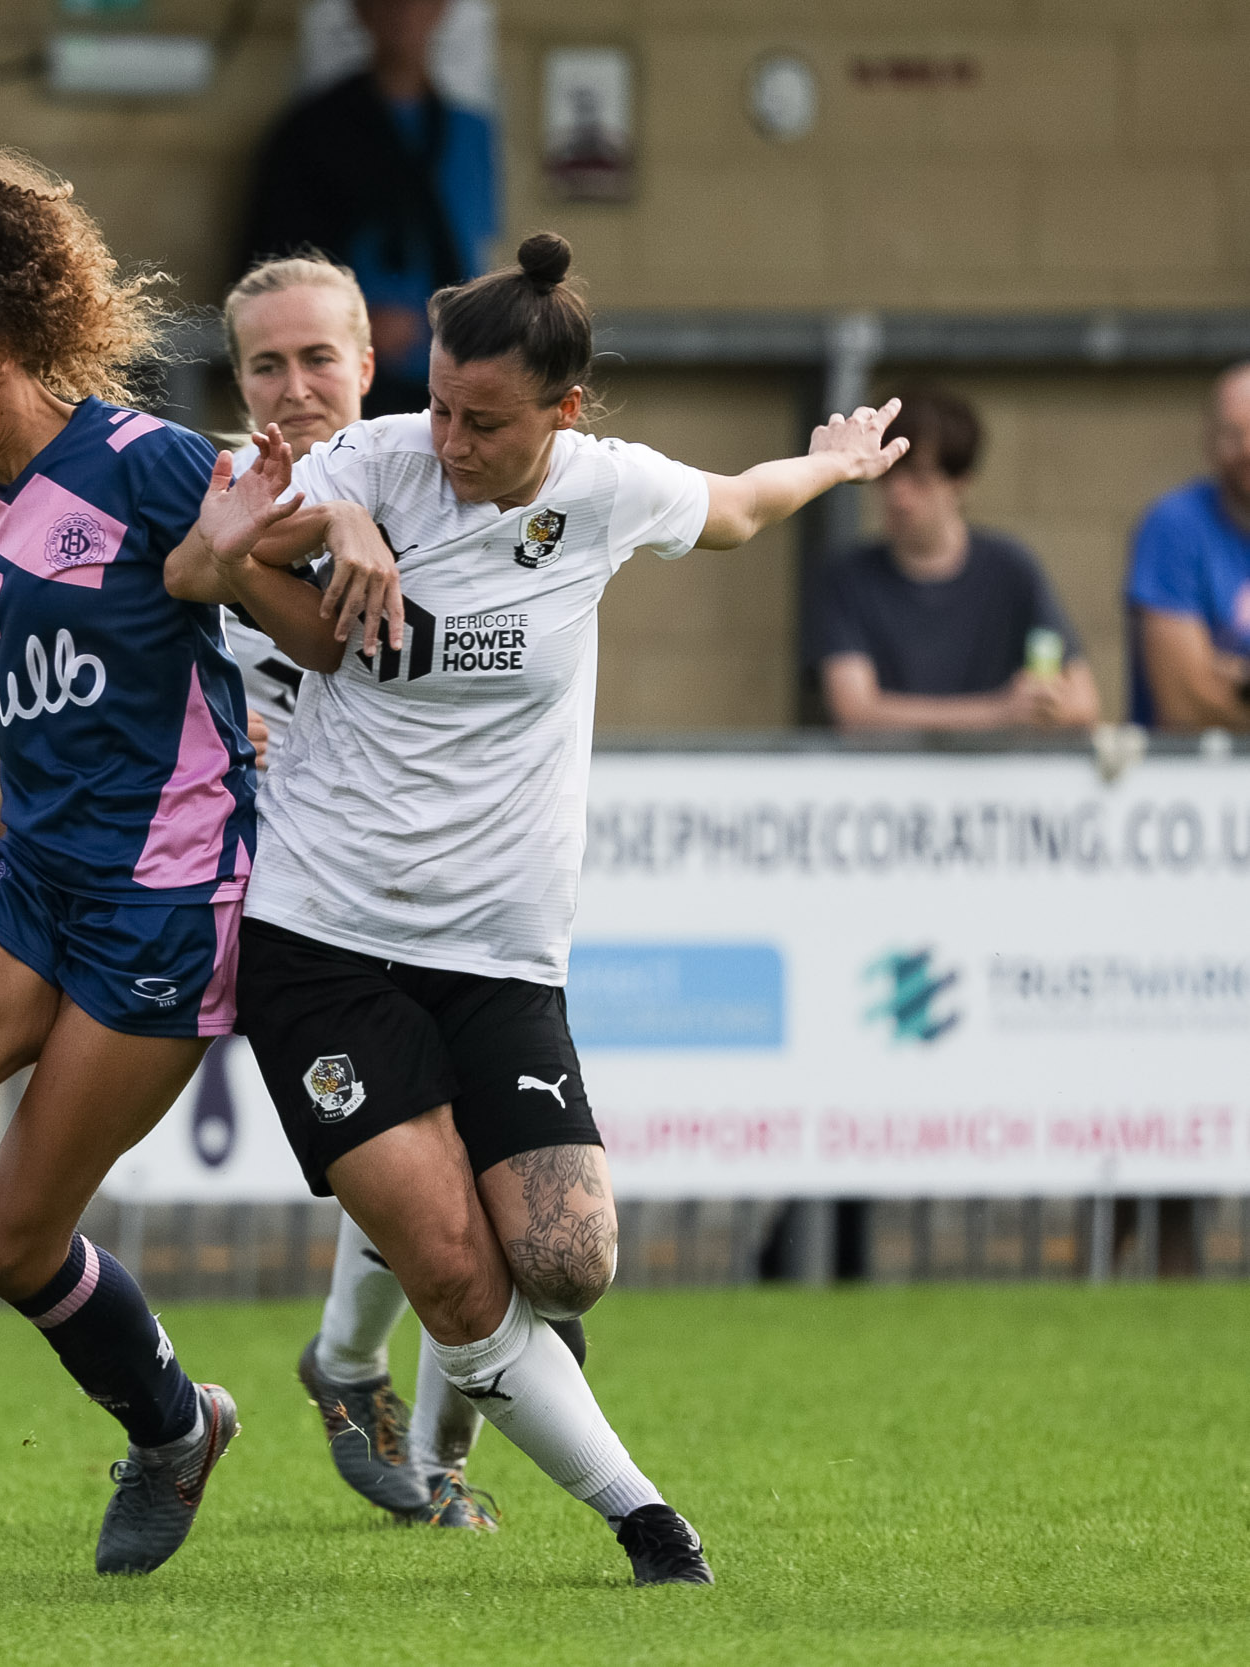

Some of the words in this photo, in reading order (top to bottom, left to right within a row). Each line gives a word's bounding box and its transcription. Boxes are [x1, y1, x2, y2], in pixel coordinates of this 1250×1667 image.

[445, 614, 529, 629] BERICOTE
[444, 629, 527, 651] POWER
[442, 651, 523, 671] HOUSE
